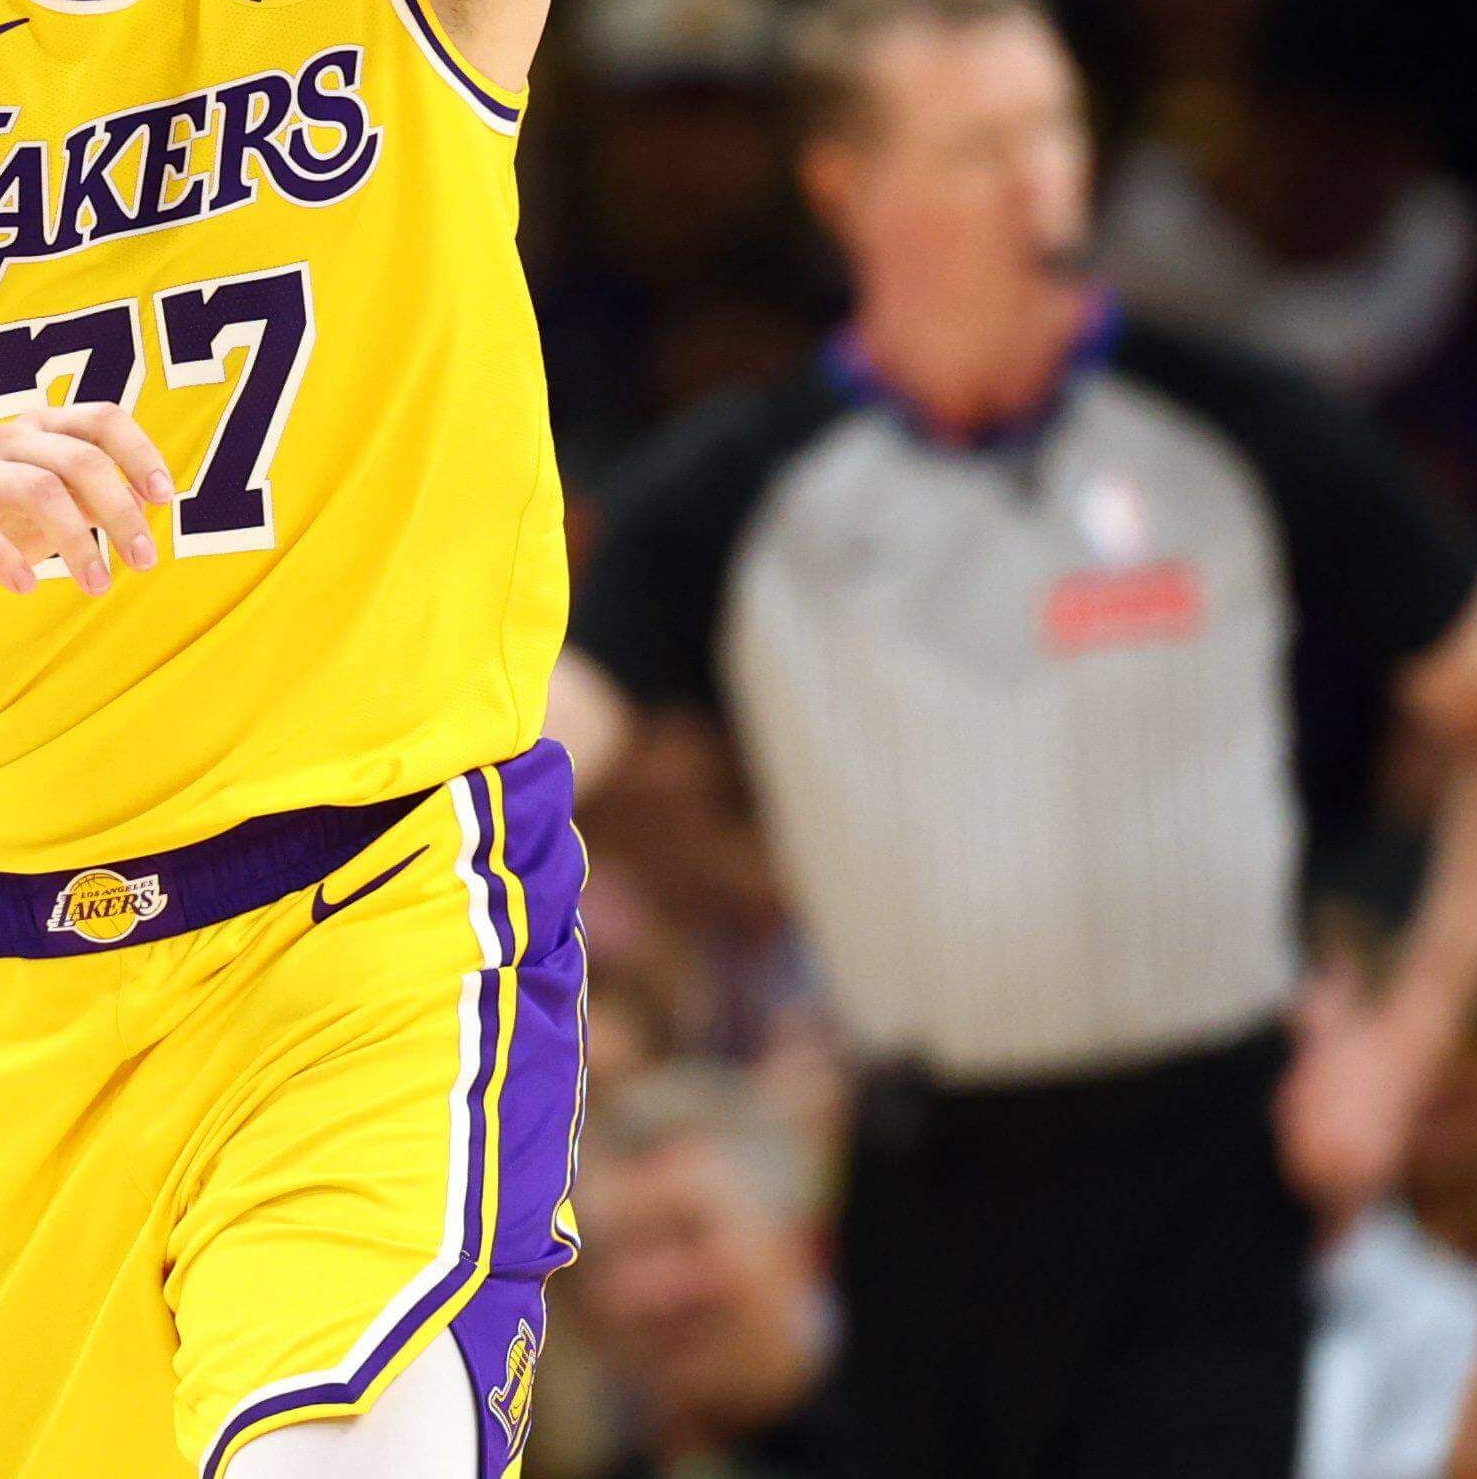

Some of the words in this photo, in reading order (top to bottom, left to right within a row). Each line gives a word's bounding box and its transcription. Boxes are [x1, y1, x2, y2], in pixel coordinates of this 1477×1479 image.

[80, 890, 100, 899] LOS
[101, 879, 155, 897] ANGELES
[51, 890, 163, 929] LAKERS
